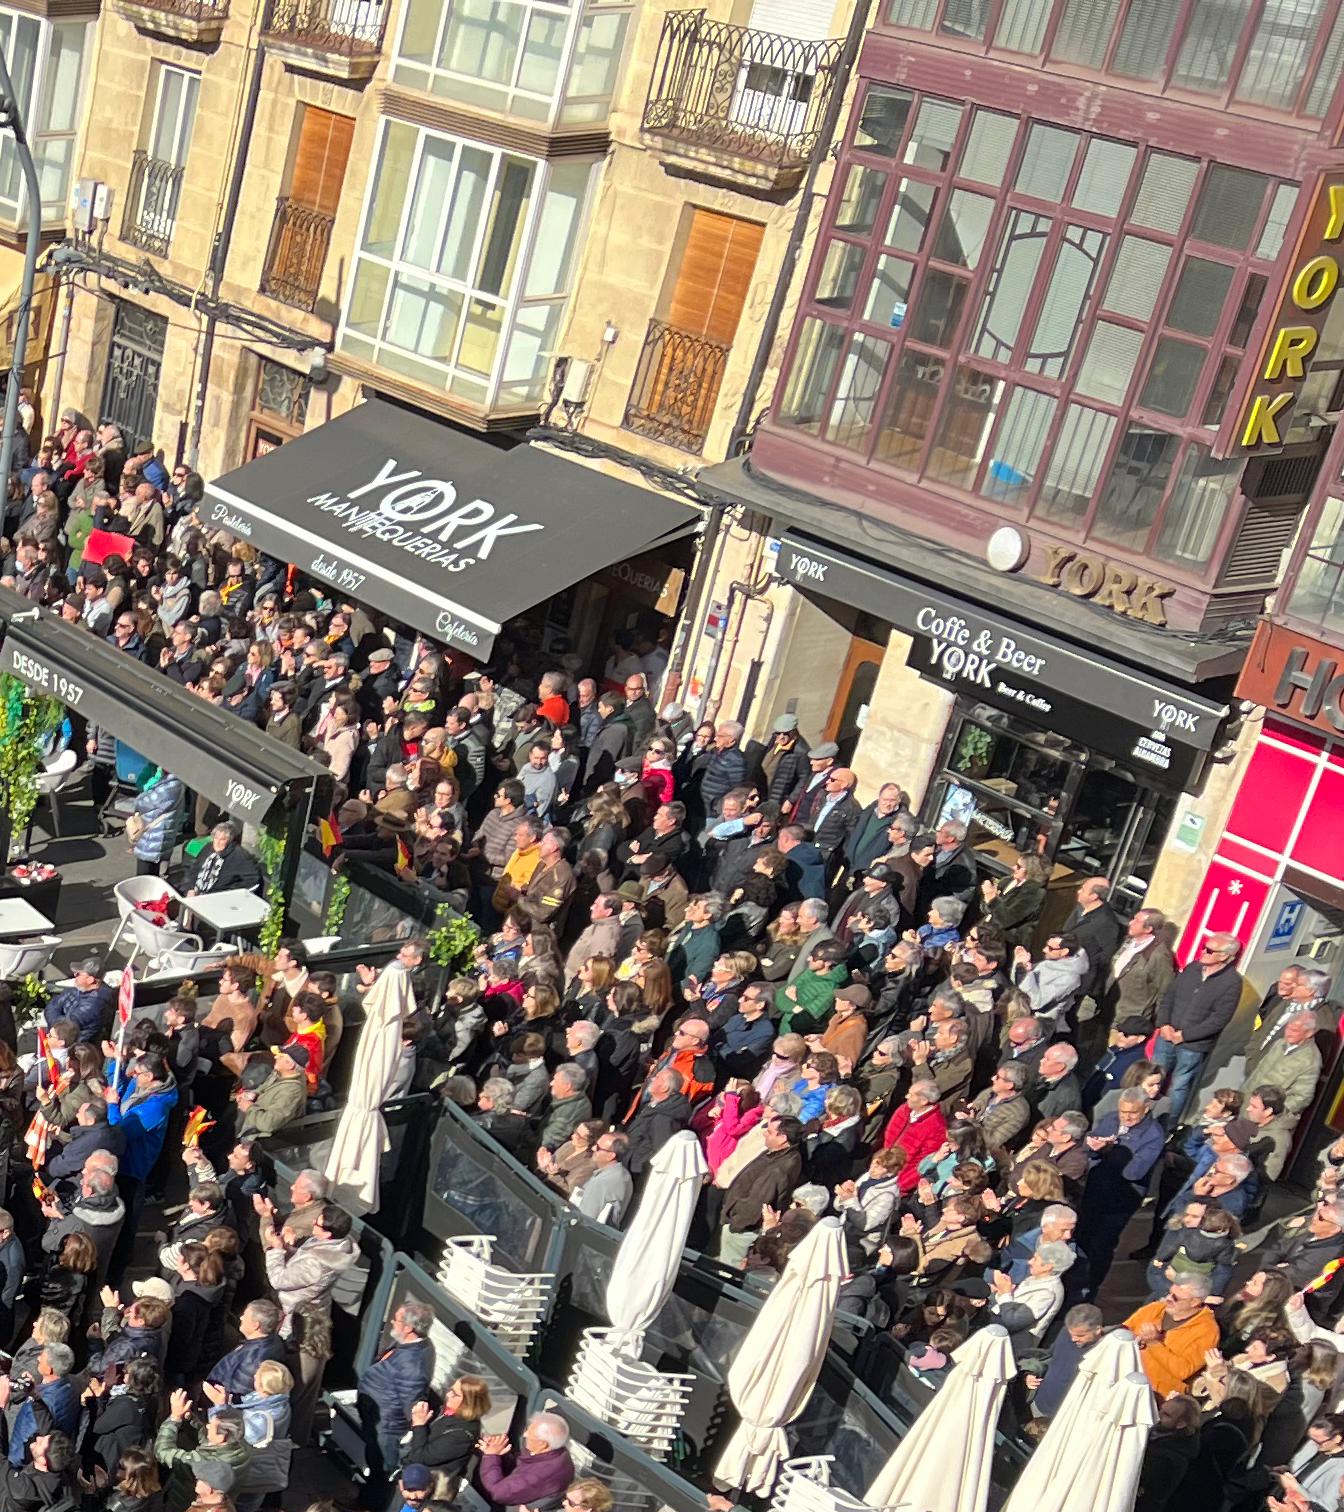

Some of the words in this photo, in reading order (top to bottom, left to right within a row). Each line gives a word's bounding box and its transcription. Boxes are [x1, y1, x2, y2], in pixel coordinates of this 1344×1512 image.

[1240, 184, 1344, 448] YORK
[307, 492, 477, 573] MANTEQUERIAS
[347, 458, 545, 560] YORK
[311, 554, 339, 582] desde
[339, 567, 366, 593] 1957
[788, 553, 828, 582] YORK
[1040, 543, 1177, 628] YORK
[917, 607, 969, 646] Coffe
[972, 629, 995, 655] &
[995, 637, 1046, 676] Beer
[929, 638, 998, 688] YORK
[12, 650, 50, 686] DESDE
[52, 674, 84, 705] 1957
[1152, 699, 1201, 732] YORK
[225, 779, 263, 810] YORK
